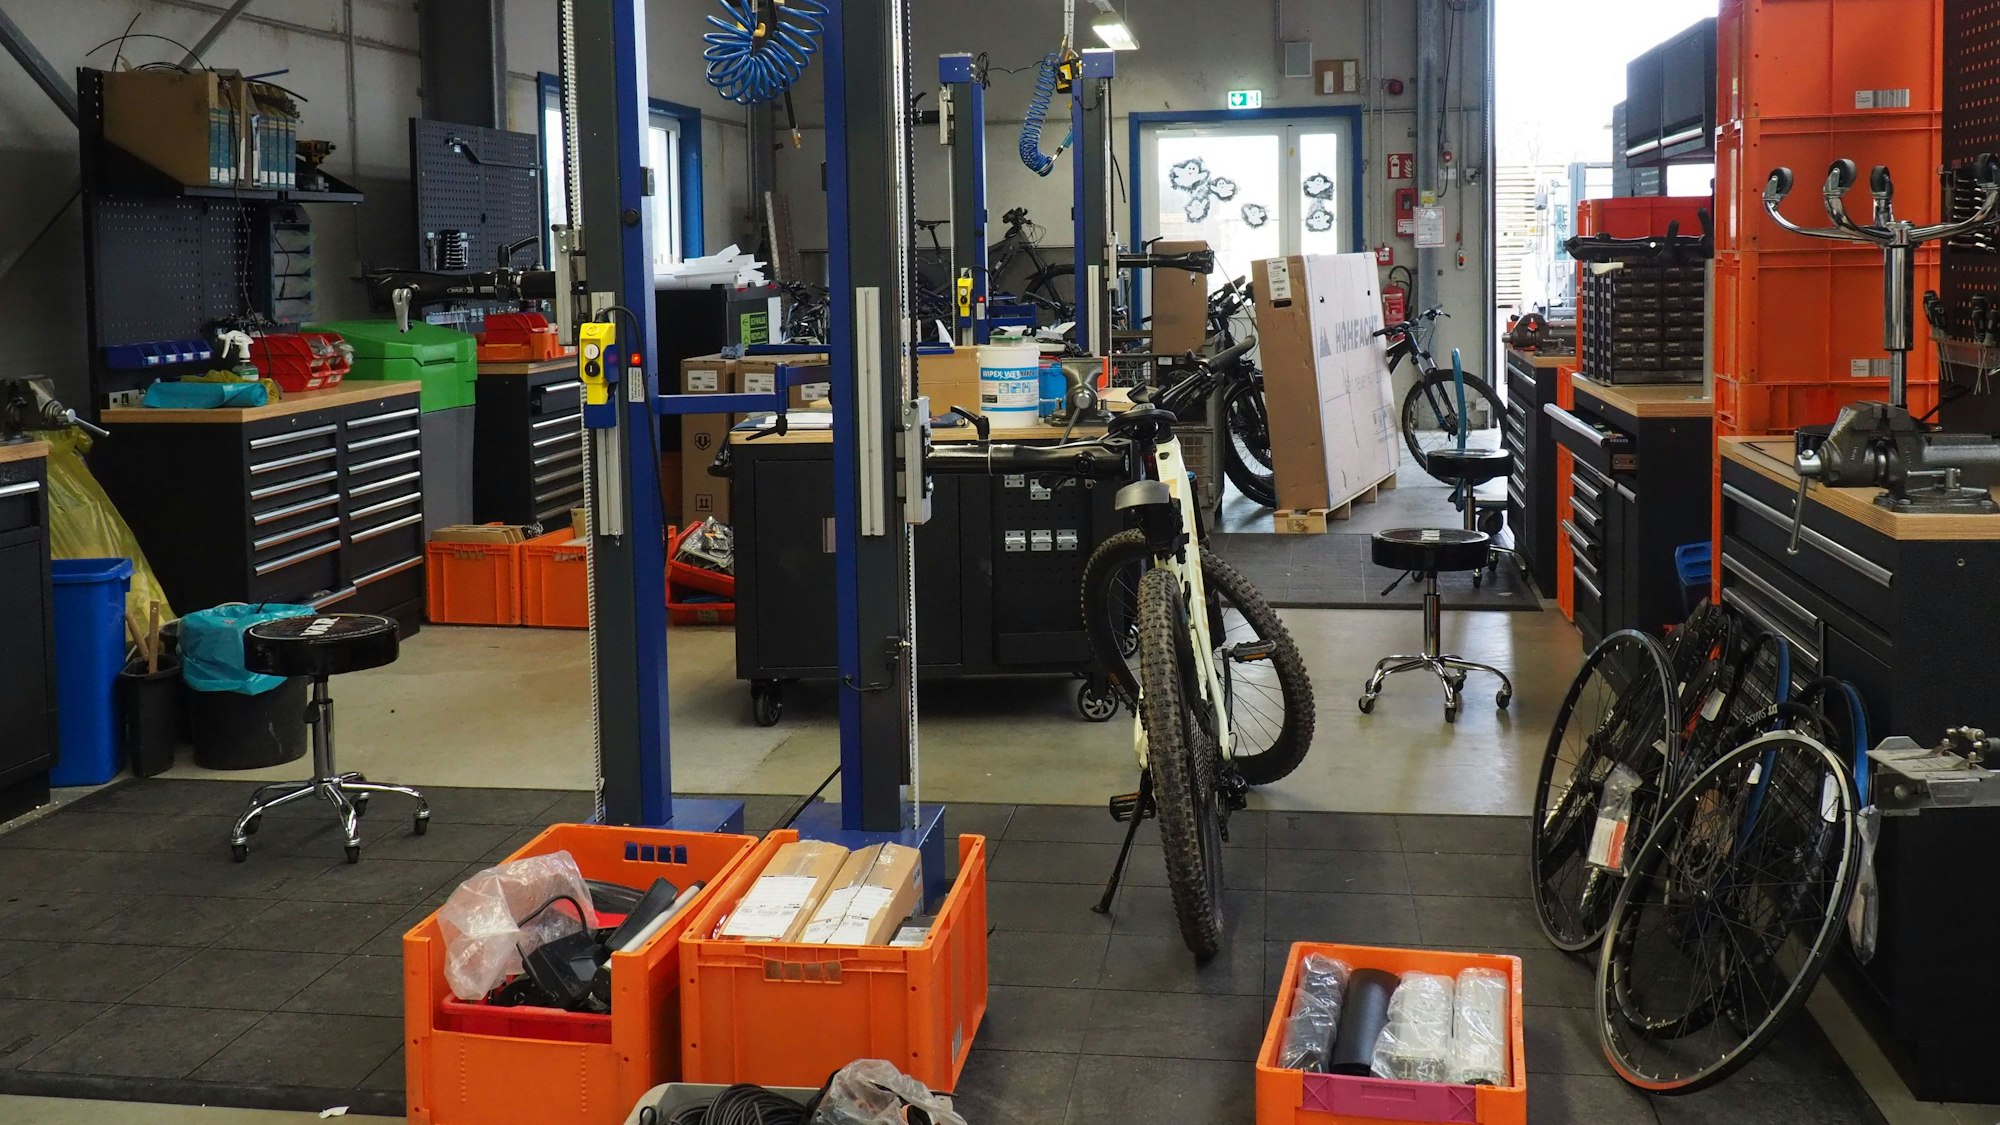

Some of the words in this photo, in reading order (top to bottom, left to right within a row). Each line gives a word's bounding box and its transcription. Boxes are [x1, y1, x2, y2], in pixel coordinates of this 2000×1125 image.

[299, 616, 341, 637] VAR
[1745, 708, 1767, 728] SWISS
[1767, 703, 1779, 717] DT
